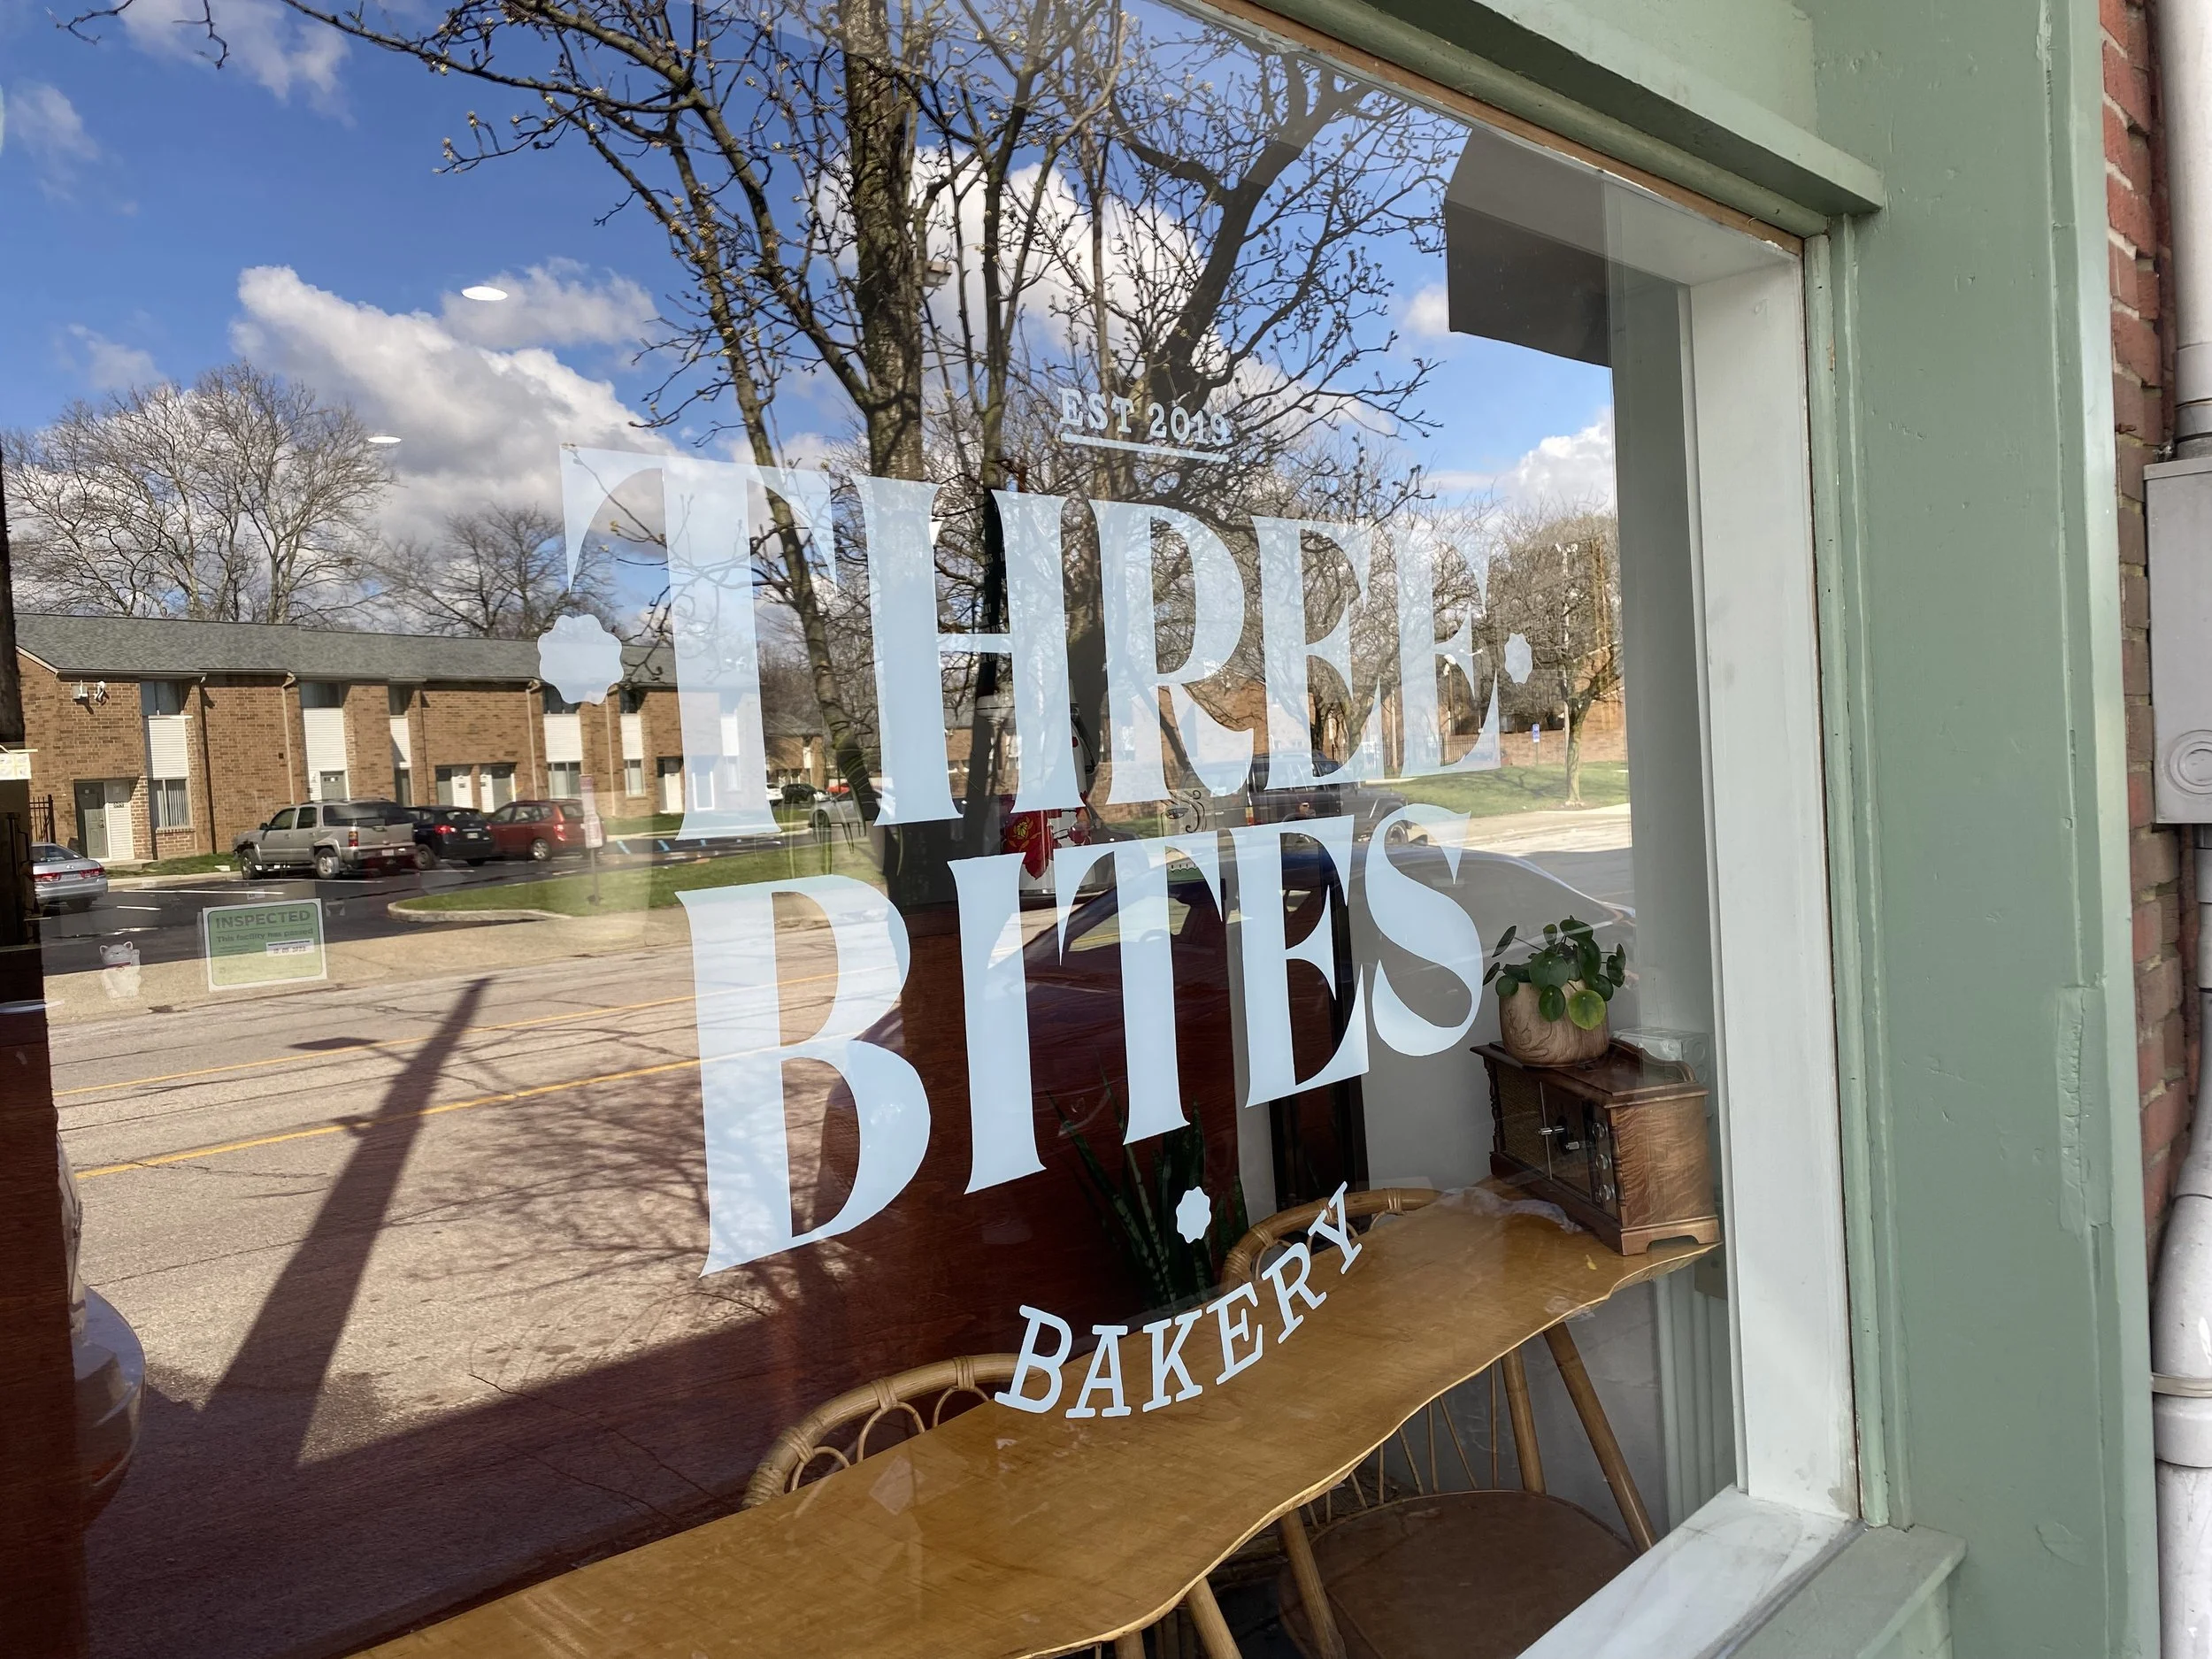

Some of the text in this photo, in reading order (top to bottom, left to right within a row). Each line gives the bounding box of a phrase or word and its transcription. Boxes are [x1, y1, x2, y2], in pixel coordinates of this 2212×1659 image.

[1057, 388, 1233, 447] EST 2019
[559, 443, 1502, 841] THREE
[216, 910, 311, 928] INSPECTED
[216, 934, 234, 943] This
[236, 933, 265, 942] facility
[284, 927, 313, 938] passed
[675, 803, 1483, 1279] BITES
[995, 1181, 1363, 1417] BAKERY
